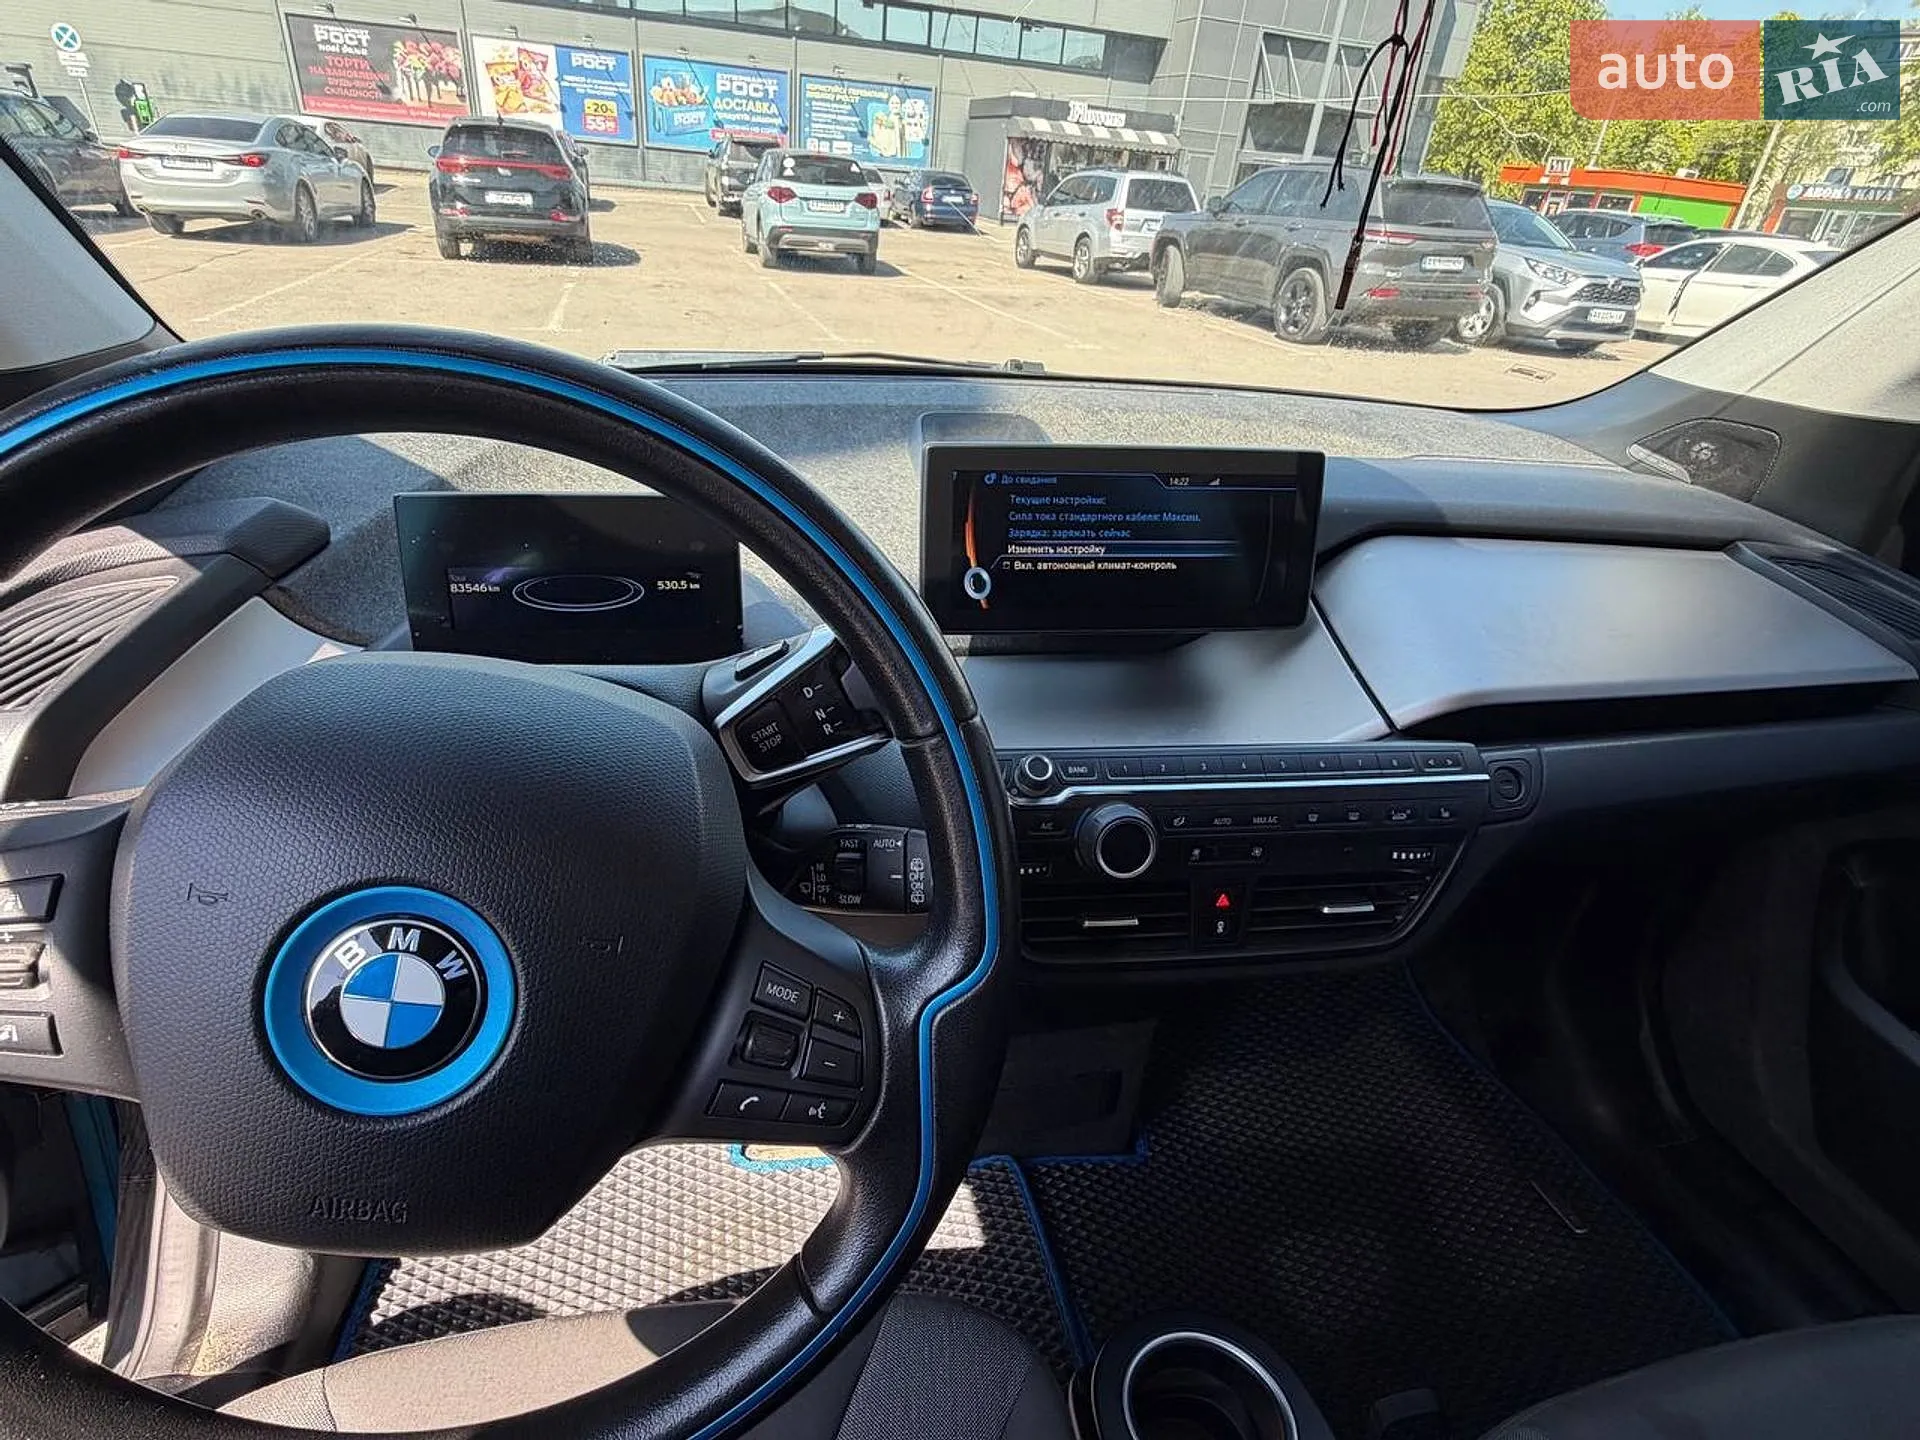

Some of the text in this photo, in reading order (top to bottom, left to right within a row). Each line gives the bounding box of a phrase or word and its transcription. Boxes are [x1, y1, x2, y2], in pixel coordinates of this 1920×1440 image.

[716, 79, 779, 98] РОСТ
[1009, 512, 1032, 521] Сила
[1034, 513, 1056, 521] тока
[1007, 544, 1106, 556] Изменить настройку
[1014, 561, 1177, 571] Вкл. автономный климат-контроль
[450, 583, 487, 593] 83546
[657, 580, 687, 590] 530.5
[803, 686, 814, 699] D
[815, 708, 827, 722] N
[752, 722, 780, 743] START
[823, 722, 834, 735] R
[759, 734, 783, 752] STOP
[840, 839, 859, 848] FAST
[873, 838, 895, 848] AUTO
[839, 894, 861, 904] SLOW
[335, 925, 469, 981] BMW
[766, 982, 800, 1004] MODE
[310, 1198, 409, 1224] AIRBAG
